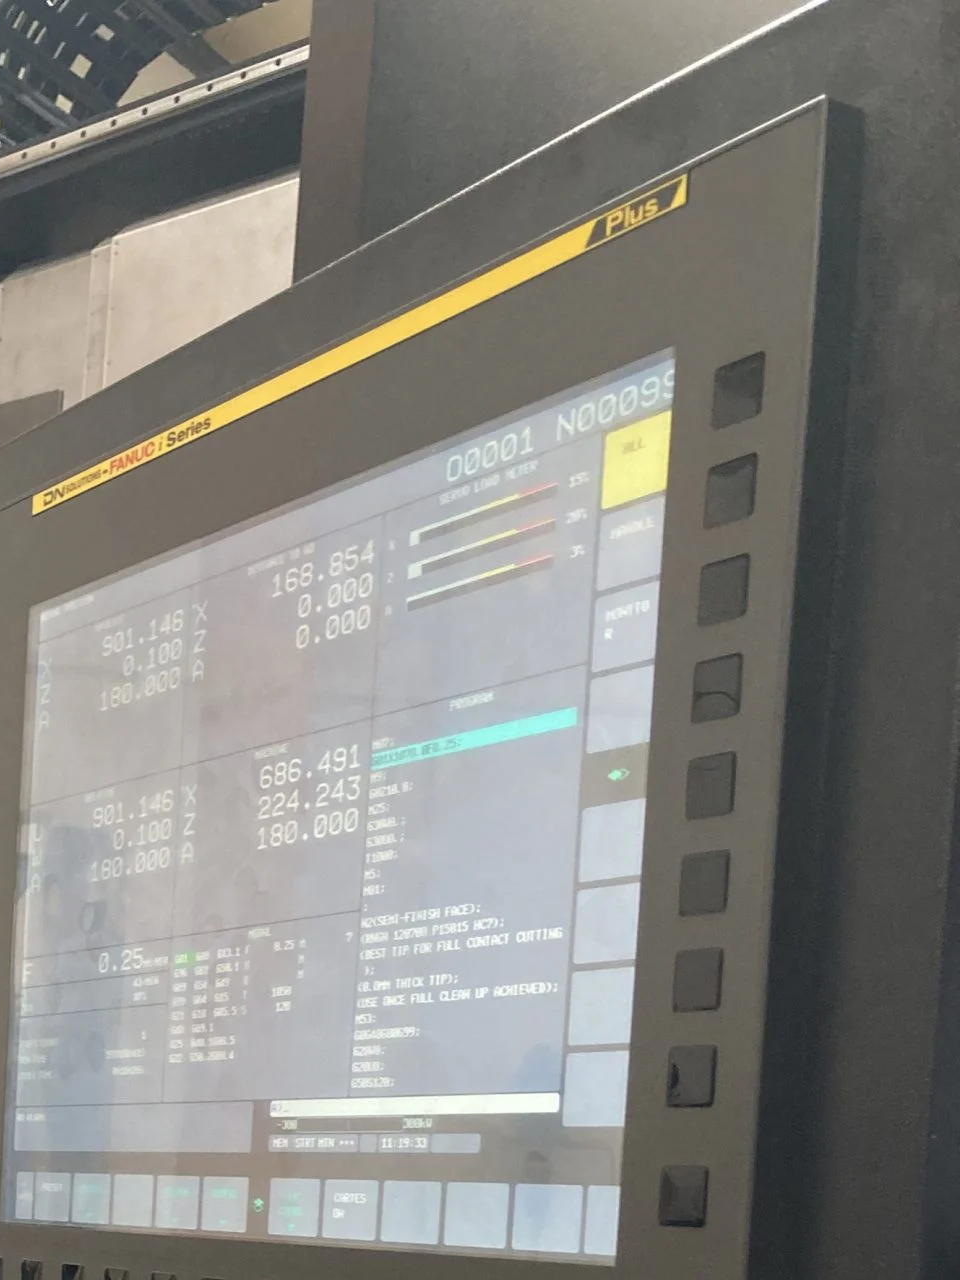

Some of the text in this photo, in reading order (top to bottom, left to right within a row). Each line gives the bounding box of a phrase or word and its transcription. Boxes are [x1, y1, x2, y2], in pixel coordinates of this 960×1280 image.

[606, 198, 658, 236] Plus
[108, 441, 155, 475] FANUC
[166, 417, 212, 447] Series
[193, 539, 375, 626] X 168.854
[100, 608, 184, 657] 901.146
[191, 571, 373, 655] Z 0.000
[190, 604, 371, 684] A 0.000
[38, 637, 183, 706] Z 0.100
[37, 666, 181, 731] A 180.000
[182, 743, 362, 807] X 686.491
[91, 789, 174, 828] 901.146
[181, 775, 361, 836] Z 224.243
[112, 818, 172, 850] 0.100
[180, 807, 360, 865] A 180.000
[90, 846, 170, 882] 180.000
[97, 947, 144, 973] 0.25
[345, 934, 353, 943] 7
[391, 945, 409, 956] TIP
[413, 942, 431, 954] FOR
[436, 939, 460, 952] FULL
[466, 933, 509, 949] CONTACT
[515, 928, 563, 943] CUTTING
[382, 994, 405, 1006] ONCE
[410, 992, 434, 1004] FULL
[438, 989, 470, 1002] CLEAN
[475, 988, 488, 999] UP
[395, 977, 424, 989] THICK
[378, 1137, 428, 1148] 11:19:33
